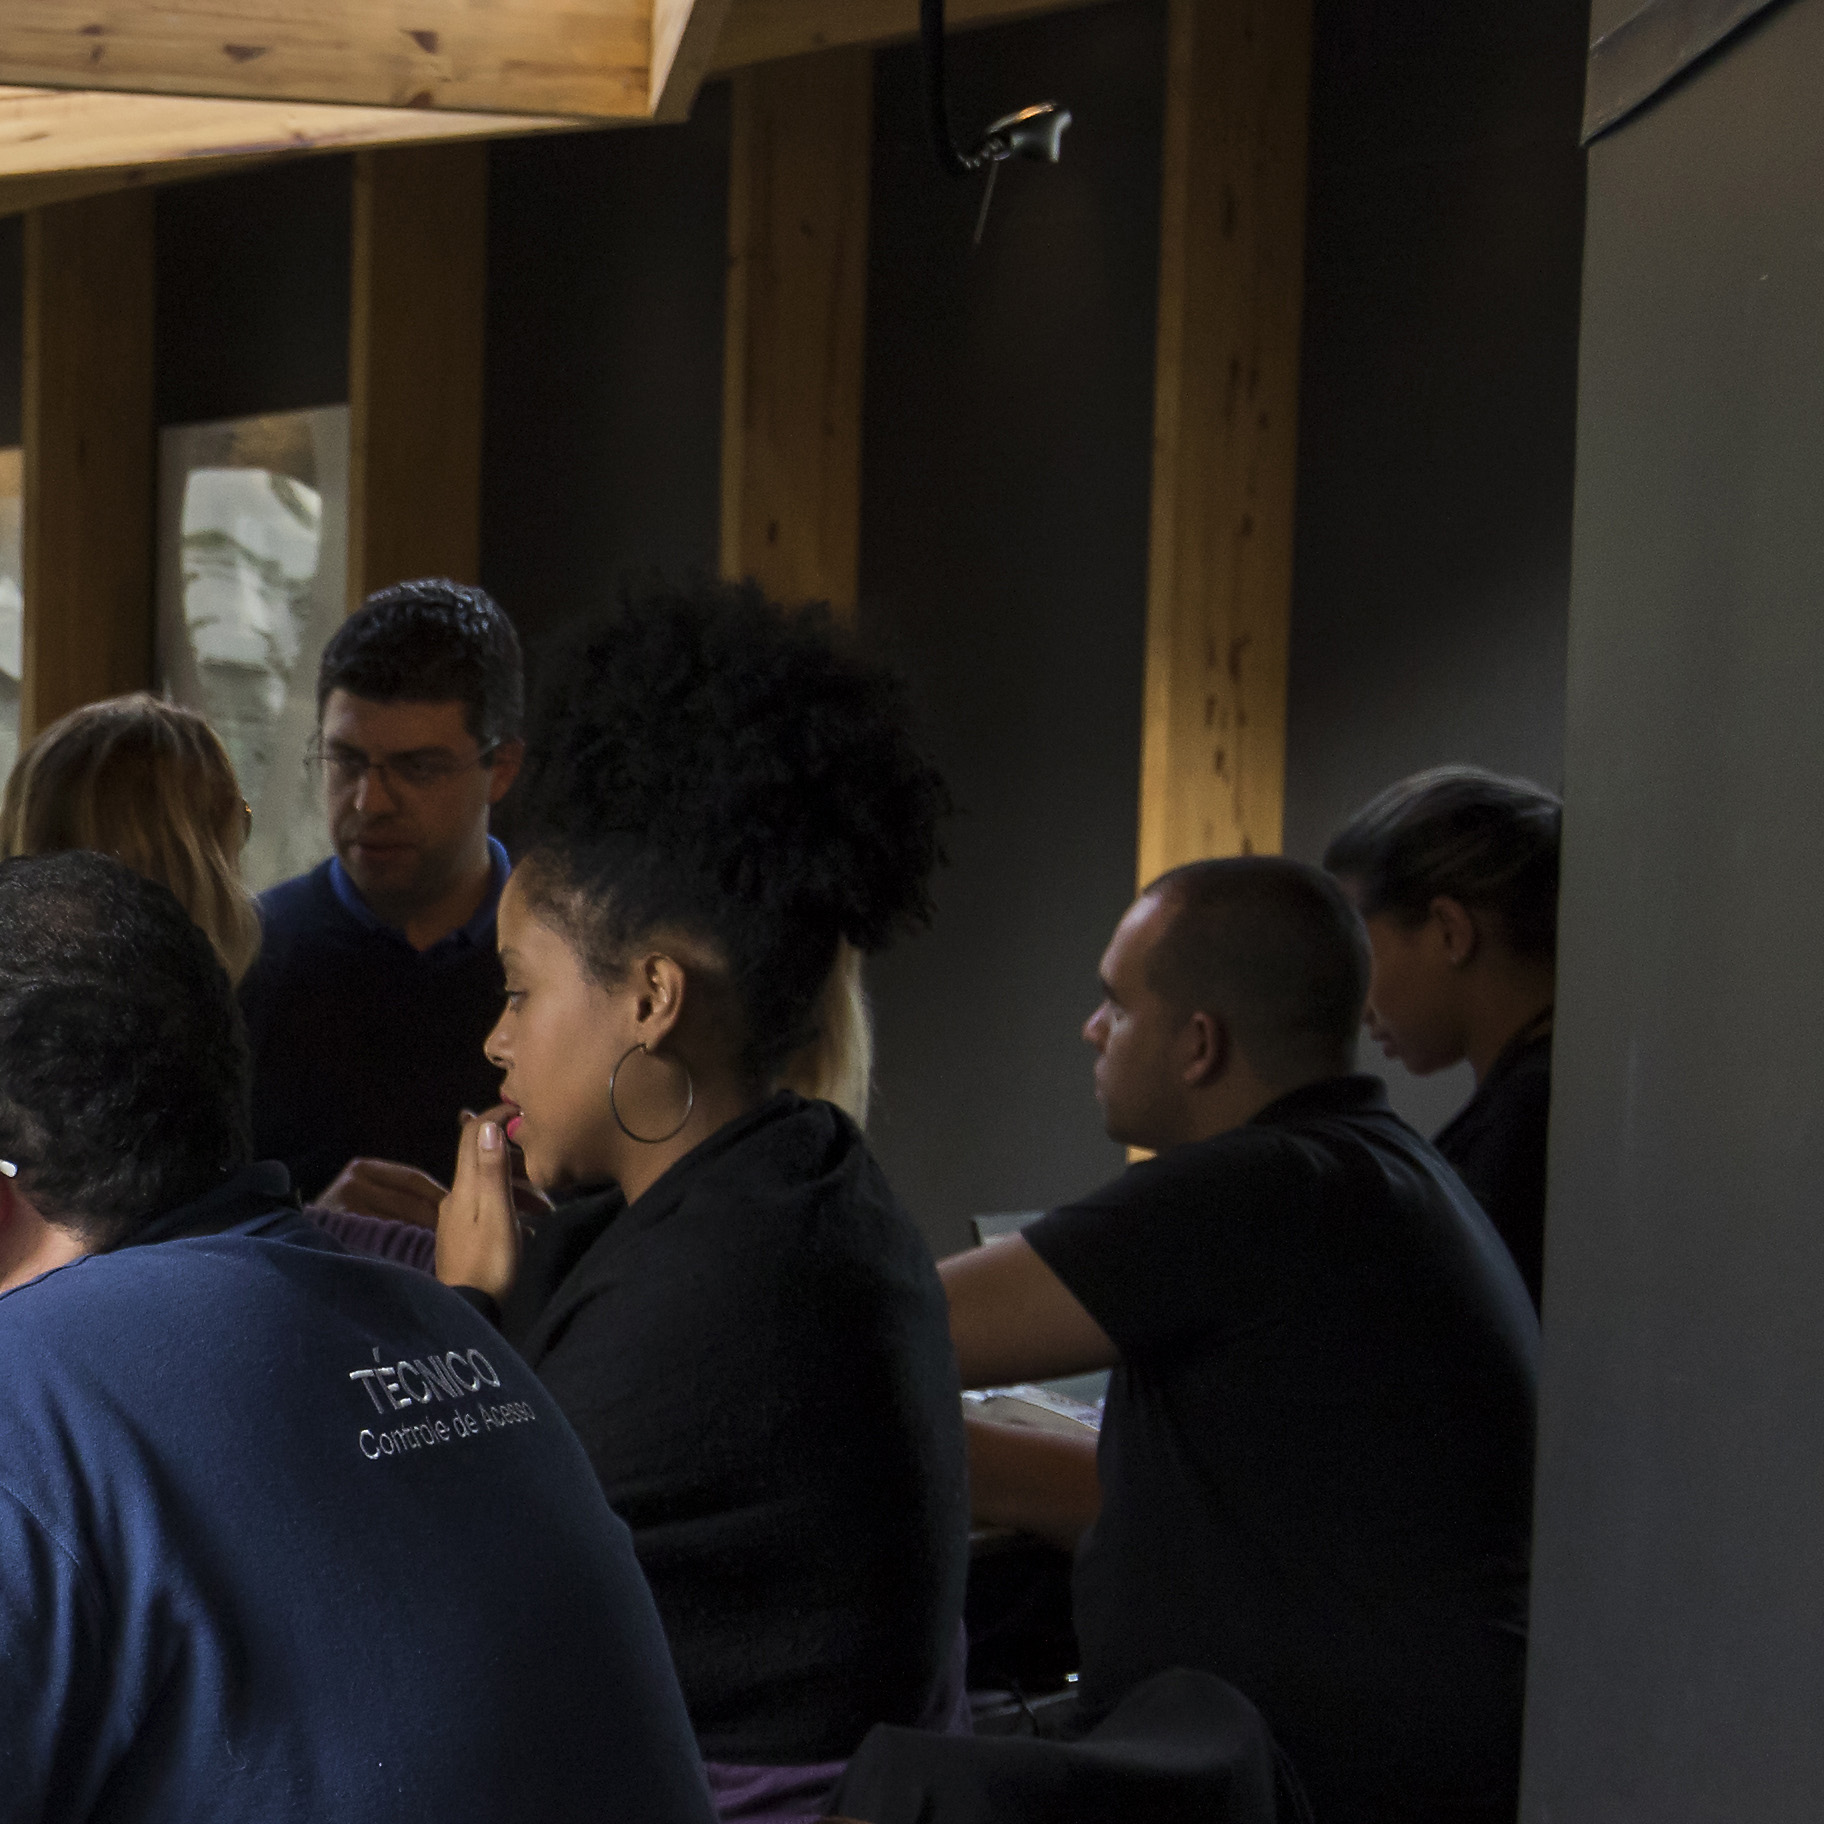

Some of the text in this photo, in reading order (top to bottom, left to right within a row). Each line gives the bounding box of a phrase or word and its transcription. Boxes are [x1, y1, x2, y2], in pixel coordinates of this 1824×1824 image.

[349, 1347, 501, 1414] TÉCNICO
[358, 1398, 535, 1460] Controle de Acesso
